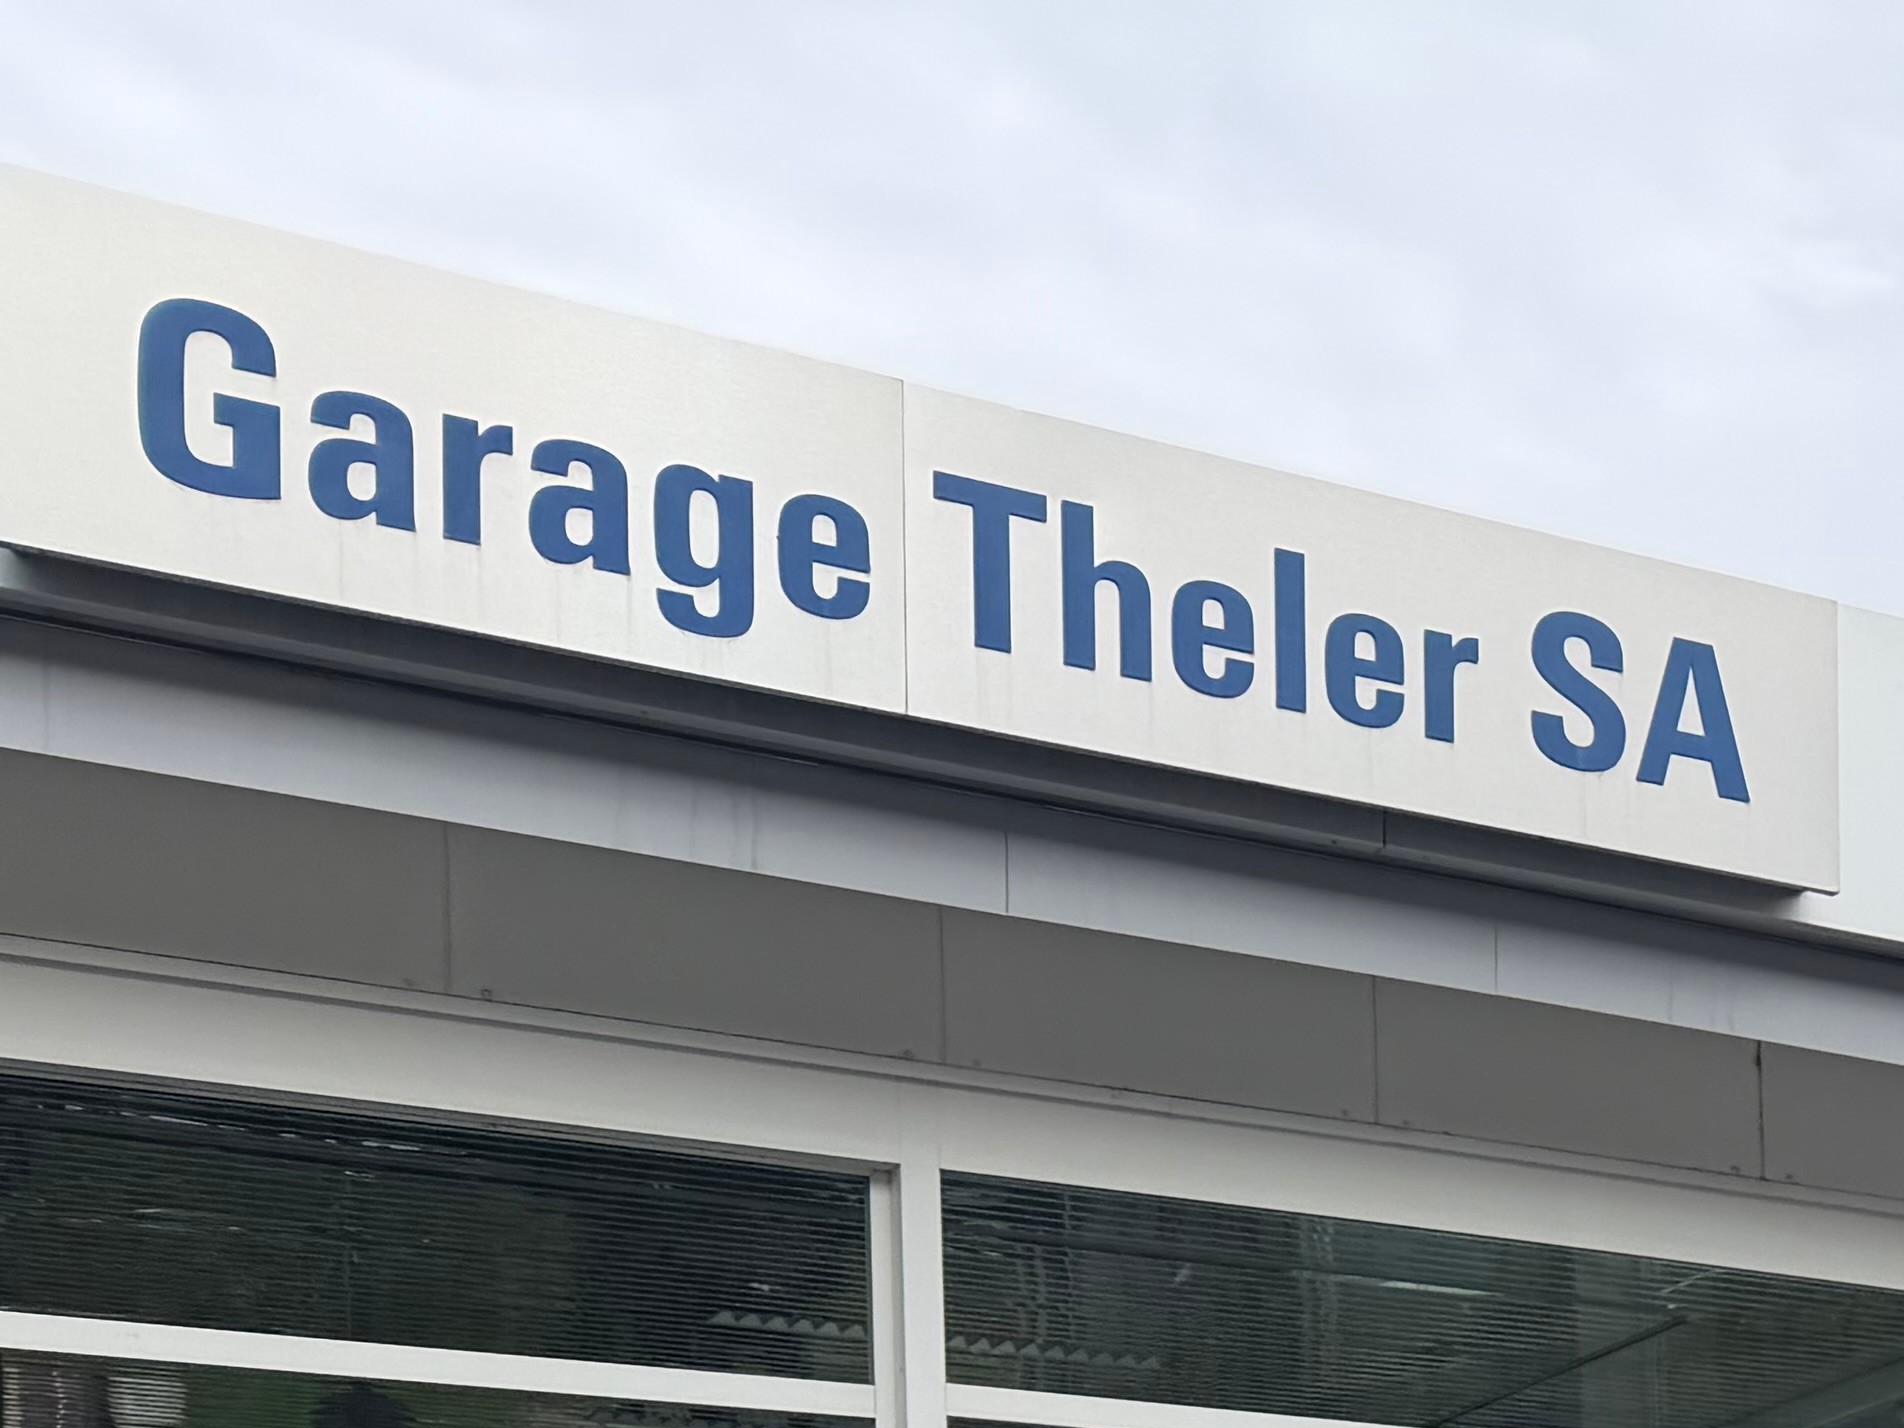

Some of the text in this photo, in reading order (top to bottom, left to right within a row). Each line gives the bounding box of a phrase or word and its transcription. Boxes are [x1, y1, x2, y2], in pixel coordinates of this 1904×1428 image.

[136, 296, 1751, 804] Garage Theler SA
